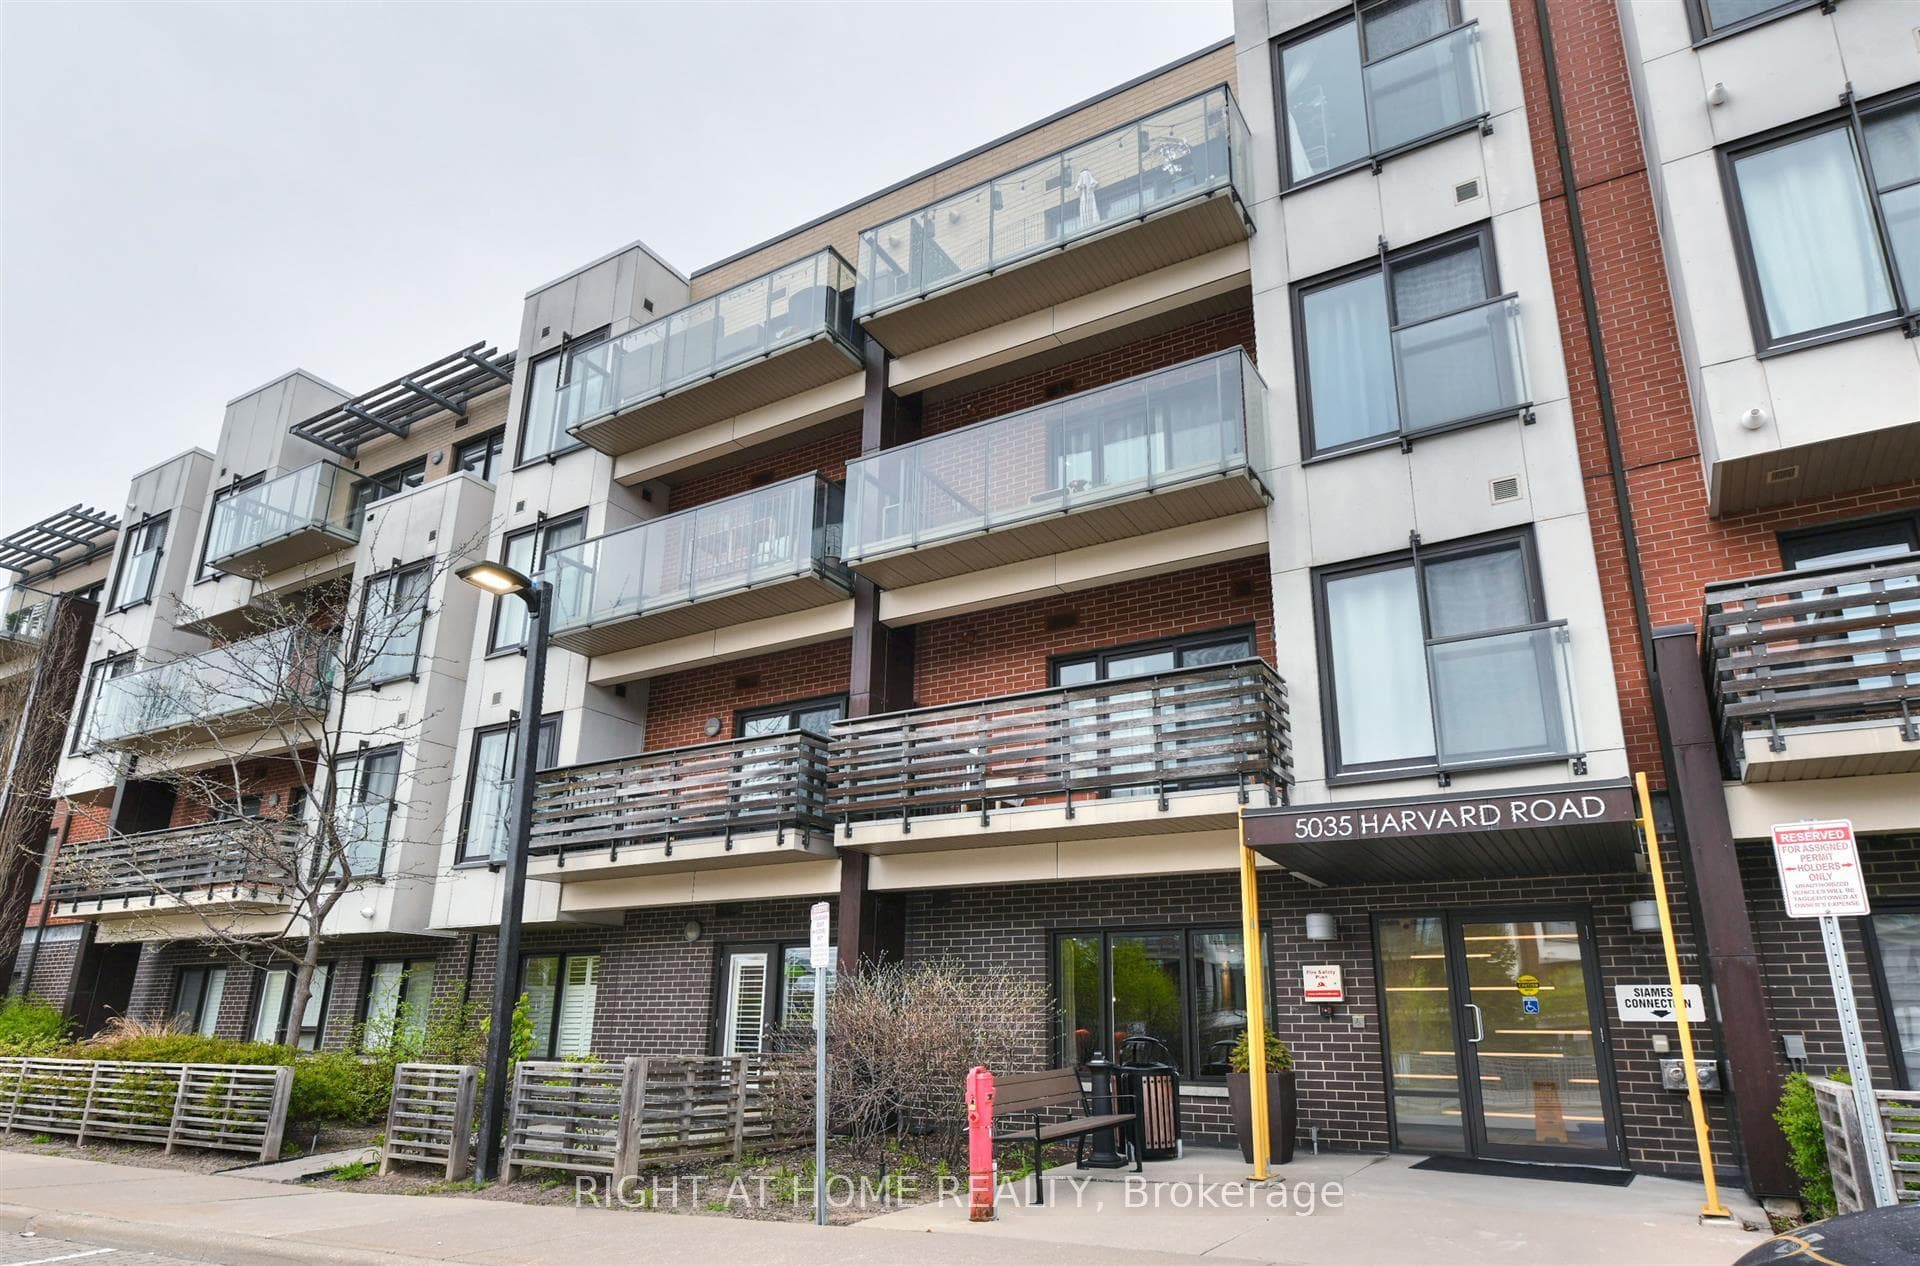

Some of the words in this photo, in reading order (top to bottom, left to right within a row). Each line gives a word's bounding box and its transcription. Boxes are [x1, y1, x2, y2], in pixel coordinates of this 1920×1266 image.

[1295, 815, 1353, 838] 5035
[1361, 804, 1501, 835] HARVARD
[1511, 796, 1606, 823] ROAD
[1780, 830, 1845, 843] RESERVED
[1782, 845, 1801, 854] FOR
[1802, 842, 1849, 852] ASSIGNED
[1800, 853, 1834, 862] PERMIT
[1797, 862, 1841, 872] HOLDERS
[1808, 872, 1833, 881] ONLY
[1633, 987, 1675, 998] SIAMES
[1624, 998, 1692, 1008] CONNECTIN
